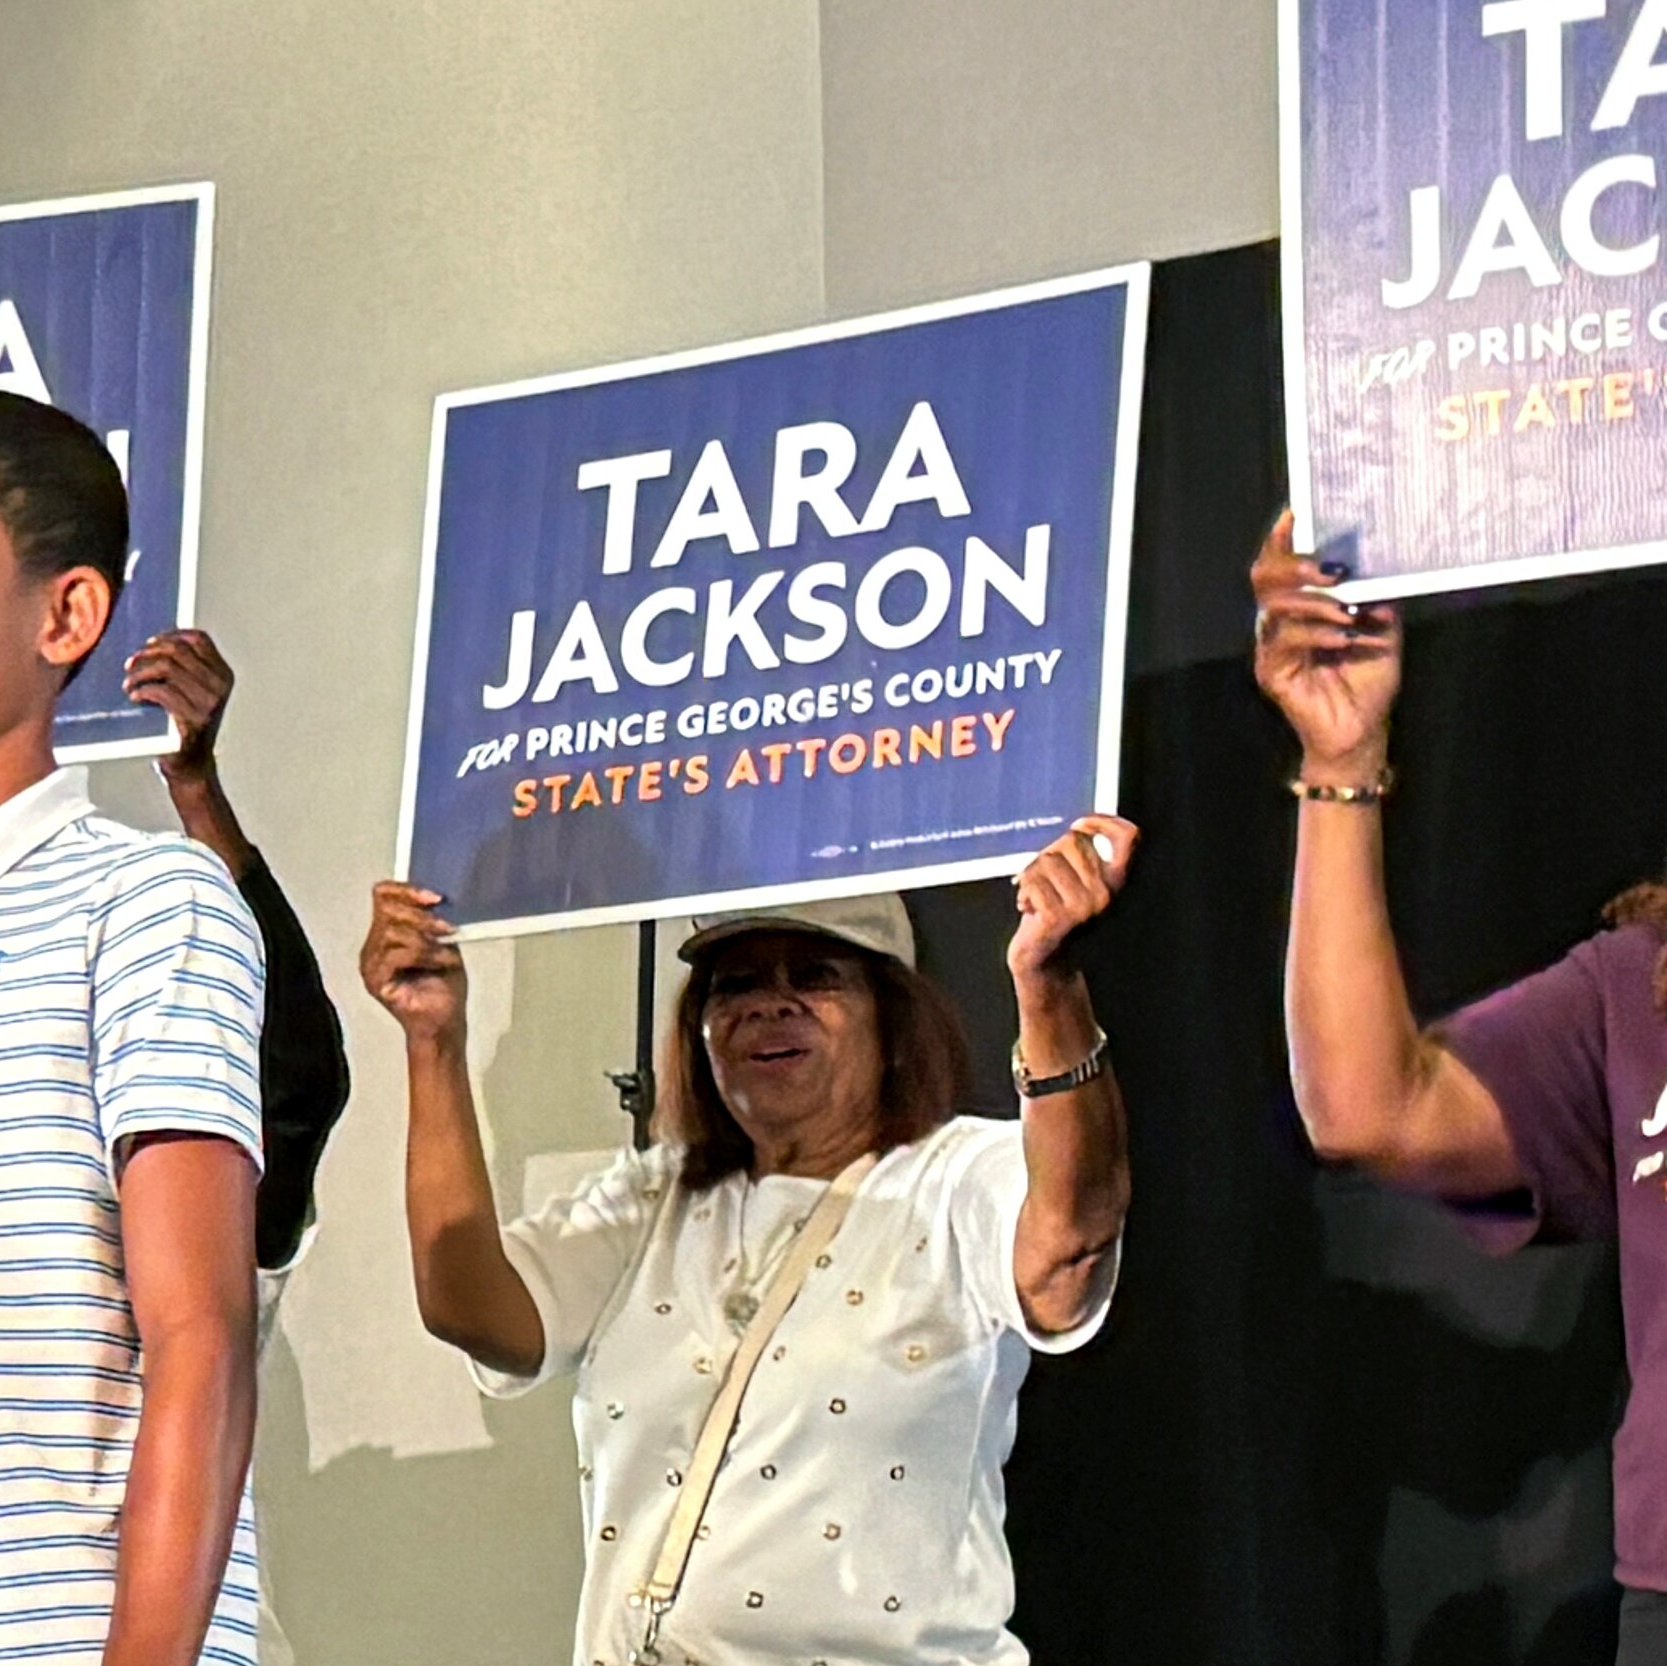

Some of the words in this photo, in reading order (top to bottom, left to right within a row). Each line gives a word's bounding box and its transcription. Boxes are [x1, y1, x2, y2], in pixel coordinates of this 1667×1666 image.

[1447, 308, 1633, 371] PRINCE
[1434, 367, 1667, 444] STATE'
[578, 401, 972, 576] TARA
[483, 523, 1051, 711] JACKSON
[456, 736, 520, 778] FOR
[526, 711, 666, 761] PRINCE
[677, 677, 873, 740] GEORGE'S
[884, 649, 1063, 707] COUNTY
[511, 753, 710, 820] STATE'S
[726, 709, 1016, 789] ATTORNEY
